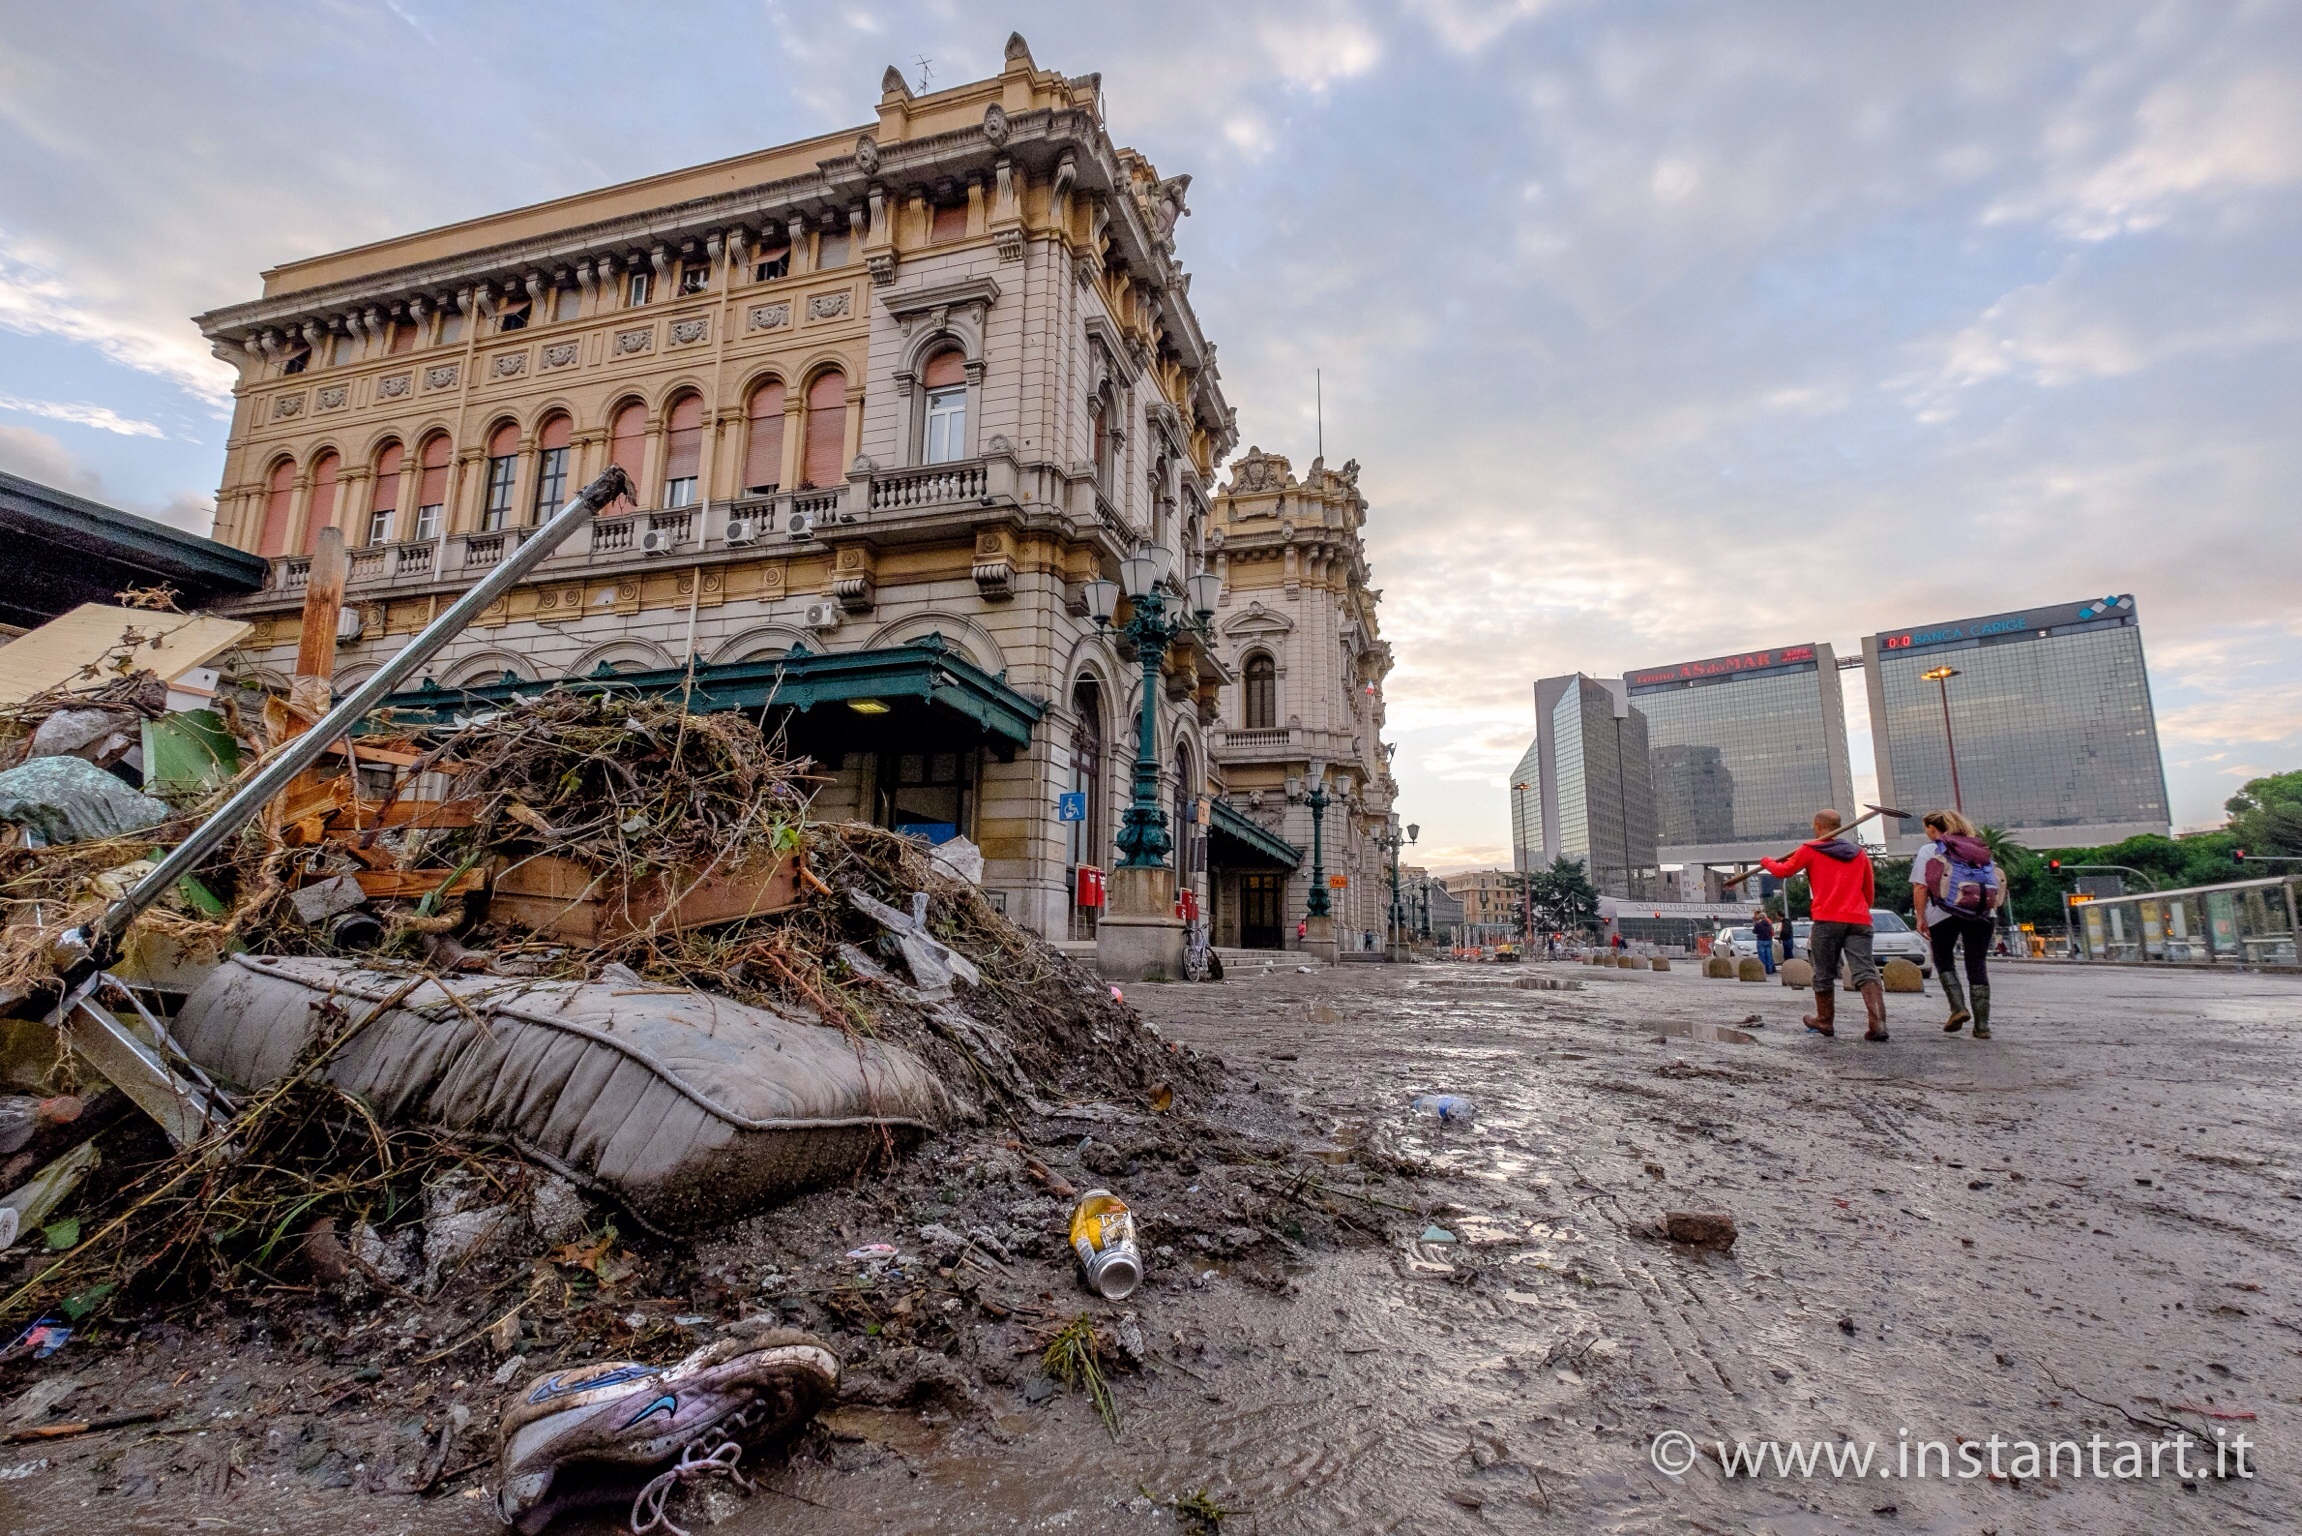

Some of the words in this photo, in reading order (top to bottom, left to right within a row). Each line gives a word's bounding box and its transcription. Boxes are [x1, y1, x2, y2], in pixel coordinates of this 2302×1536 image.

[1914, 629, 1963, 644] BANCA
[1970, 619, 2026, 635] CARIGE
[1636, 903, 1691, 912] STARHOTEL
[1695, 904, 1749, 913] PRESIDENT
